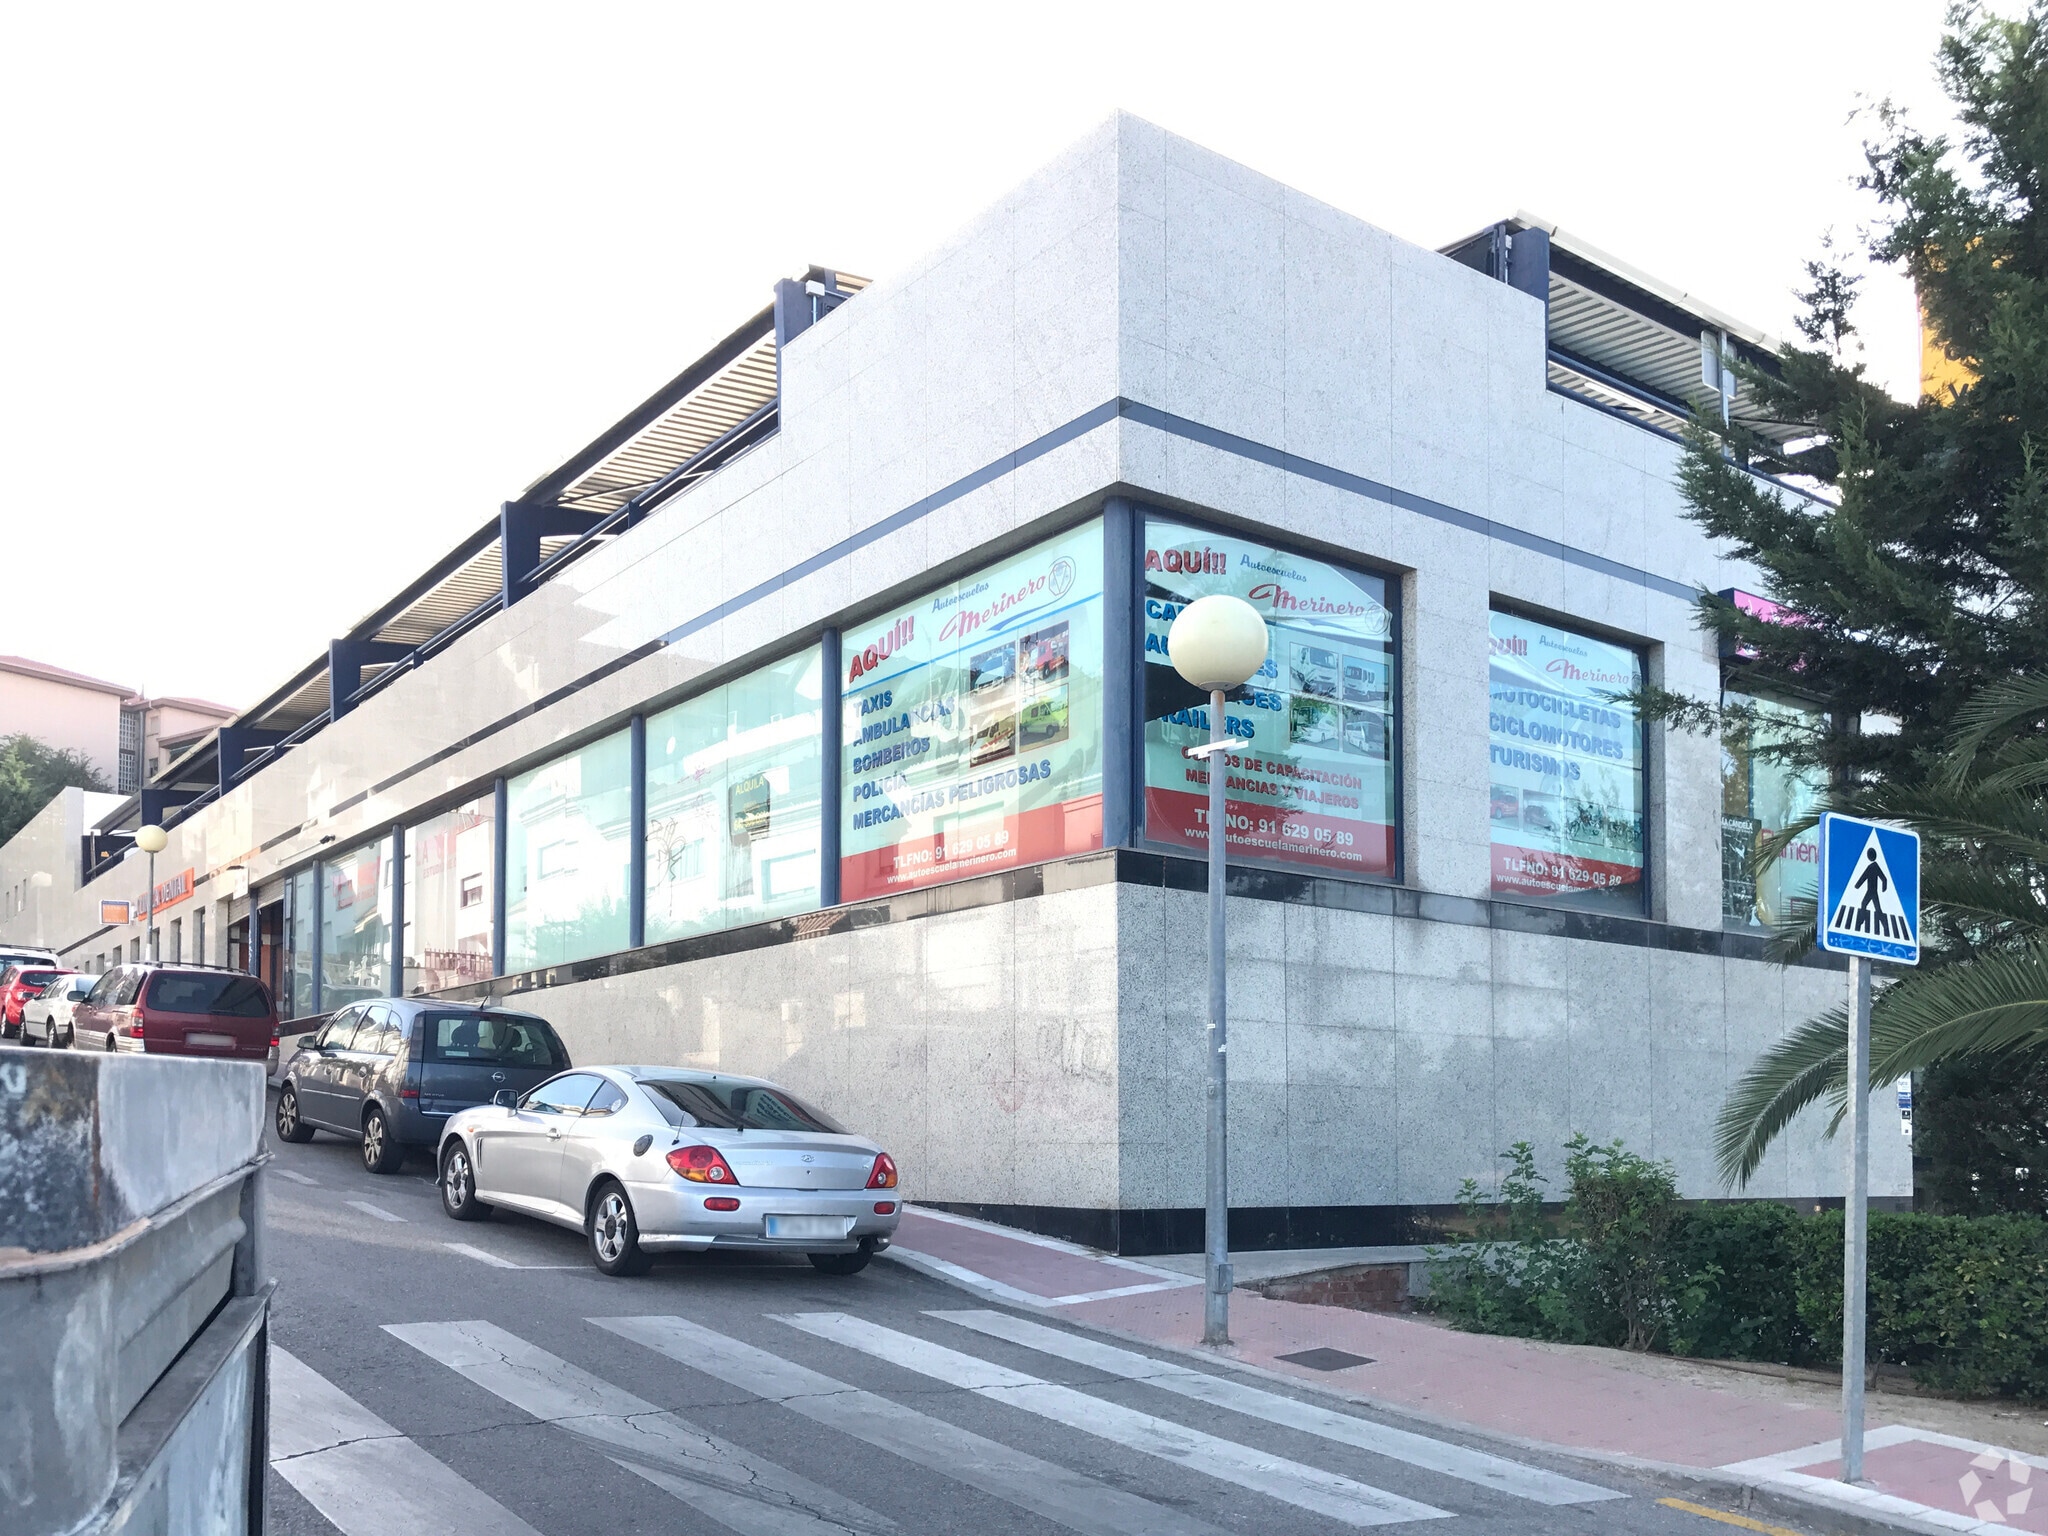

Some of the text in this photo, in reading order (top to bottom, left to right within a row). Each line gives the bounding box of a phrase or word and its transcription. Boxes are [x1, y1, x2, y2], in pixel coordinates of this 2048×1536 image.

[1145, 546, 1227, 575] AQUÍ!!
[1240, 553, 1307, 582] Autoescuelas
[932, 582, 989, 614] Autoescuelas
[939, 575, 1046, 642] Merinero
[1248, 583, 1366, 617] Merinero
[849, 615, 914, 684] AQUÍ!!
[1539, 634, 1588, 657] Autoescuelas
[1546, 658, 1631, 684] Merinero
[853, 690, 893, 718] TAXIS
[1490, 712, 1624, 760] CICLOMOTORES
[853, 737, 931, 774] BOMBEROS
[1490, 744, 1581, 781] TURISMOS
[735, 775, 764, 795] ALQUILA
[948, 759, 1051, 804] PELIGROSAS
[1185, 768, 1359, 810] MEANCIAS Y VIAJEROS
[1244, 757, 1263, 773] DE
[1266, 761, 1363, 790] CAPACITACIÓN
[952, 838, 973, 856] 629
[977, 833, 991, 849] 05
[1258, 818, 1277, 835] 91
[1282, 822, 1310, 840] 629
[1314, 827, 1332, 844] 05
[1336, 830, 1354, 846] 89
[1568, 868, 1590, 883] 629
[1592, 871, 1607, 886] 05
